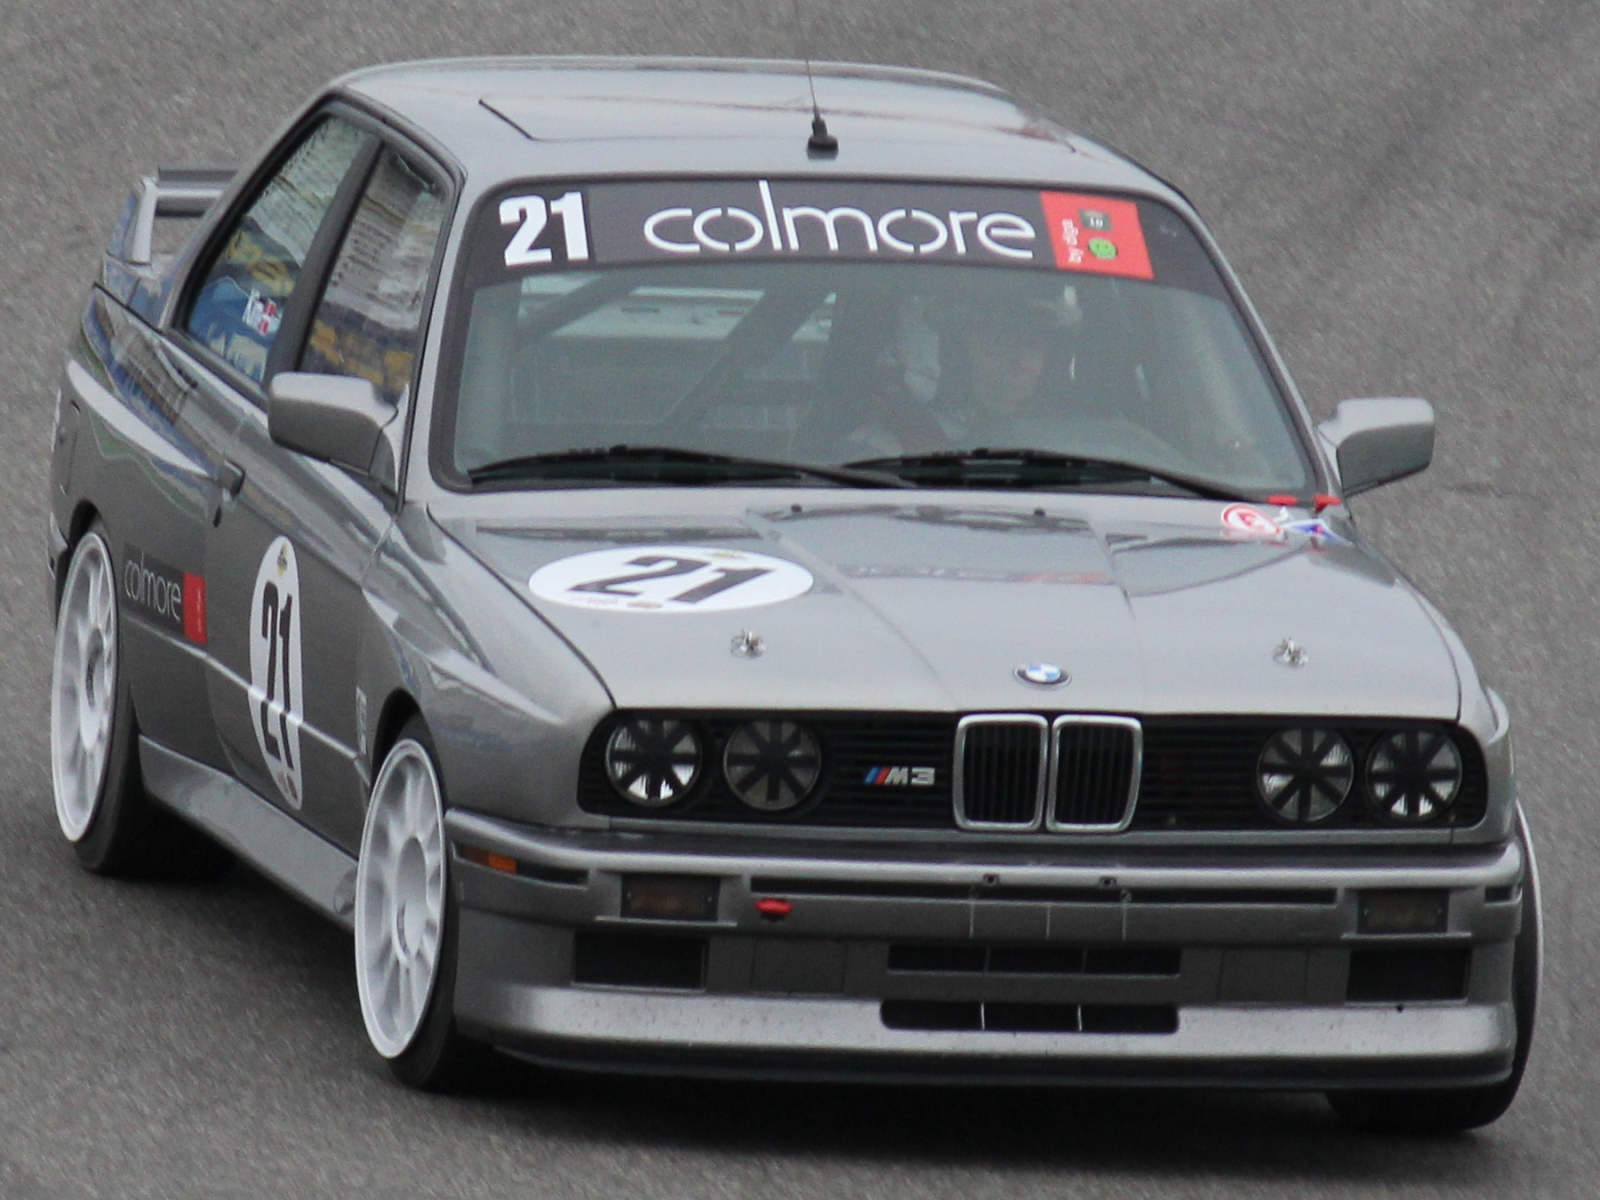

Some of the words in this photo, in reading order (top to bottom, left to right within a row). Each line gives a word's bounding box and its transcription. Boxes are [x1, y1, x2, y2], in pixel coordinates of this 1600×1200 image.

[499, 191, 589, 266] 21
[643, 179, 1036, 260] colmore
[124, 552, 182, 622] colmore
[566, 556, 775, 604] 21
[261, 580, 294, 771] 21
[883, 766, 936, 786] M3
